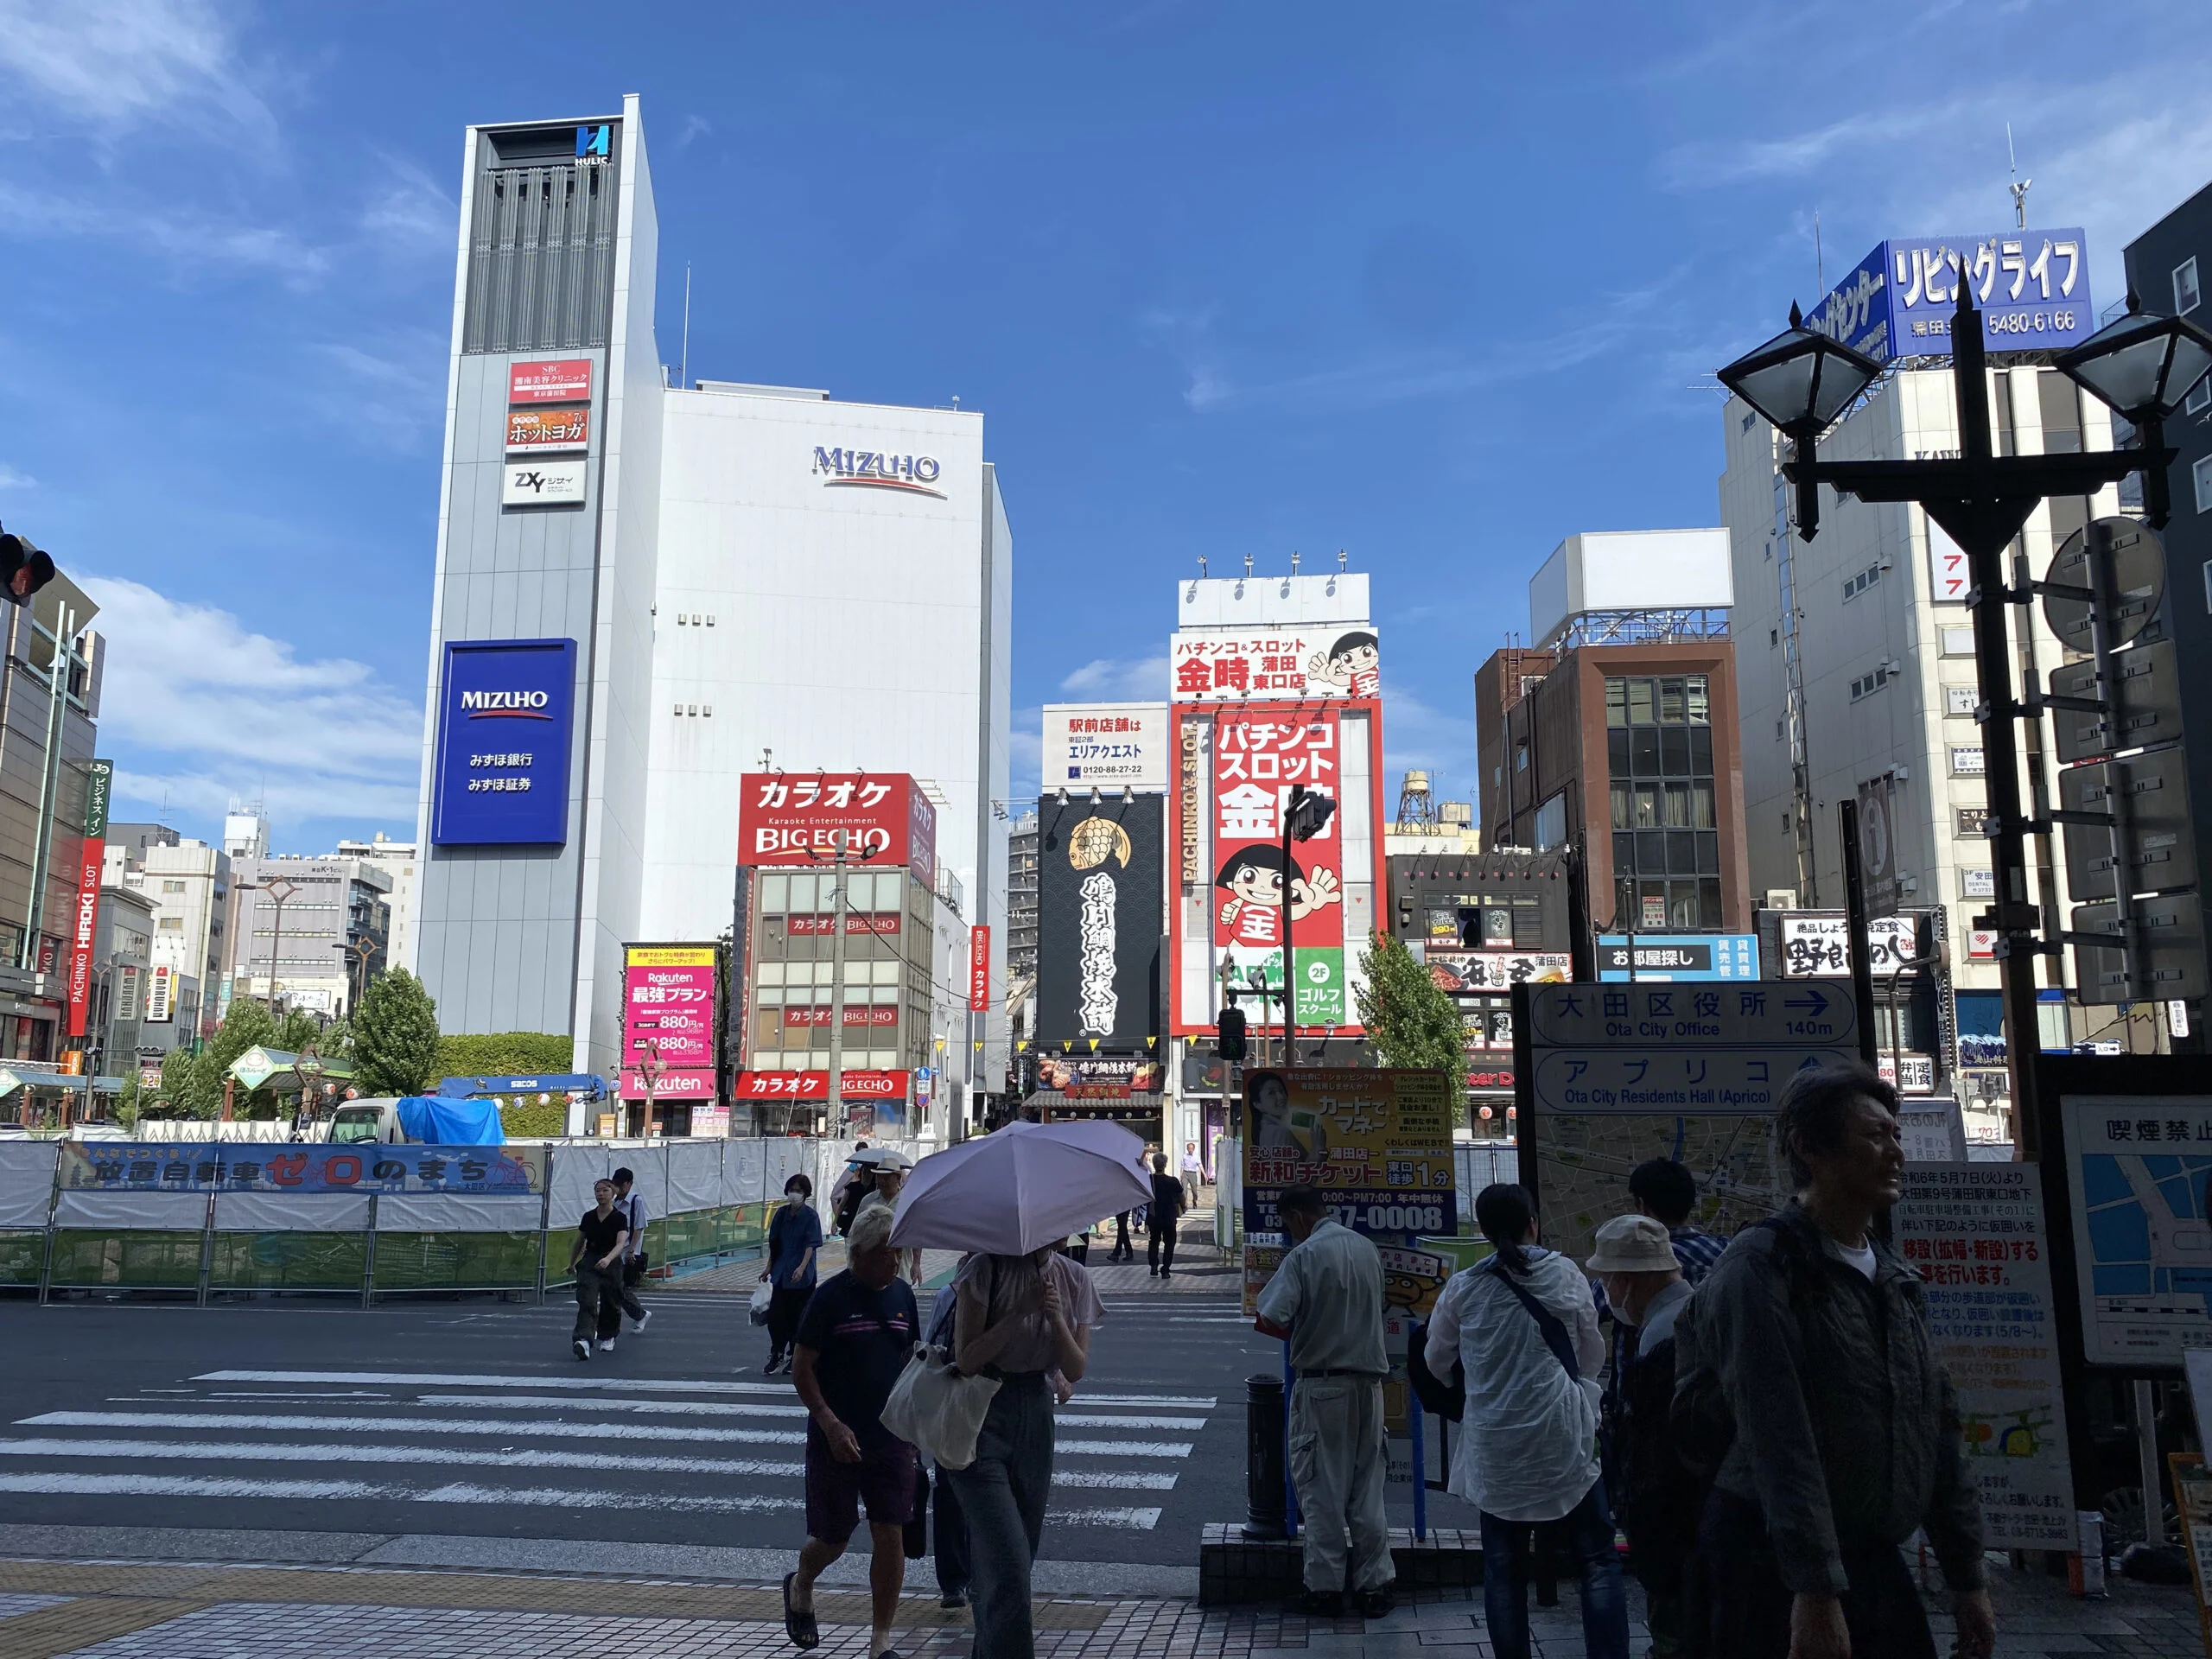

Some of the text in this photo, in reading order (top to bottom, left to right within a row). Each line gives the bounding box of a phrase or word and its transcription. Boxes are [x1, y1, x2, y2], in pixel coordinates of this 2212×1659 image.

[575, 157, 607, 166] HULIC
[1896, 239, 2079, 308] リビングライフ
[1987, 310, 2076, 334] 5480-6166
[542, 365, 561, 373] SBC
[514, 373, 588, 385] 湘南美容クリニック
[510, 423, 586, 443] ホットヨガ
[813, 445, 941, 480] MIZUHO
[515, 472, 546, 493] ZXY
[1261, 656, 1297, 673] 蒲田
[1176, 657, 1250, 692] 金時
[1253, 672, 1306, 690] 東口店
[461, 690, 548, 710] MIZUHO
[1069, 717, 1141, 733] 駅前店舗は
[1219, 721, 1334, 752] パチンコ
[469, 753, 533, 768] みずほ銀行
[1069, 744, 1141, 759] エリアクエスト
[1219, 752, 1334, 779] スロット
[467, 778, 532, 792] みずほ証券
[92, 778, 105, 815] ビジネス
[758, 781, 892, 809] カラオケ
[756, 827, 891, 854] BIG ECHO
[1183, 791, 1198, 881] PACHINKO
[847, 920, 865, 930] BIG
[1240, 904, 1276, 942] 金
[1796, 921, 1900, 934] 絶品しょう焼定食
[73, 864, 97, 1003] PACHINKO HIROKI SLOT
[1535, 956, 1568, 967] 蒲田店
[648, 972, 693, 983] Rakuten
[1312, 968, 1326, 978] 2F
[632, 987, 707, 1003] 最強プラン
[975, 969, 985, 1008] カラオケ
[1299, 988, 1340, 1002] ゴルフ
[1299, 1004, 1342, 1014] スクール
[1557, 991, 1767, 1020] 大田区役所
[844, 1012, 863, 1022] BIG
[1605, 1020, 1833, 1039] Ota City Office 140m
[1563, 1059, 1770, 1085] アプリコ
[752, 1077, 819, 1093] カラオケ
[857, 1078, 893, 1092] ECHO
[1319, 1096, 1389, 1116] カードで
[1564, 1089, 1770, 1108] Ota City Residents Hall (Aprico)
[1334, 1116, 1387, 1135] マネー
[2107, 1120, 2212, 1141] 喫煙禁止
[1249, 1146, 1300, 1160] 安心店舗の
[95, 1152, 488, 1185] 放置自転車ゼロのまち
[1248, 1160, 1384, 1186] 新和チケット
[1386, 1161, 1414, 1173] 東口
[1386, 1173, 1414, 1185] 徒歩
[1397, 1192, 1445, 1204] 年中無休
[1899, 1187, 2032, 1201] 大田第9号蒲田駅東口地下
[1903, 1238, 2039, 1262] 移設(拡幅・新設)する
